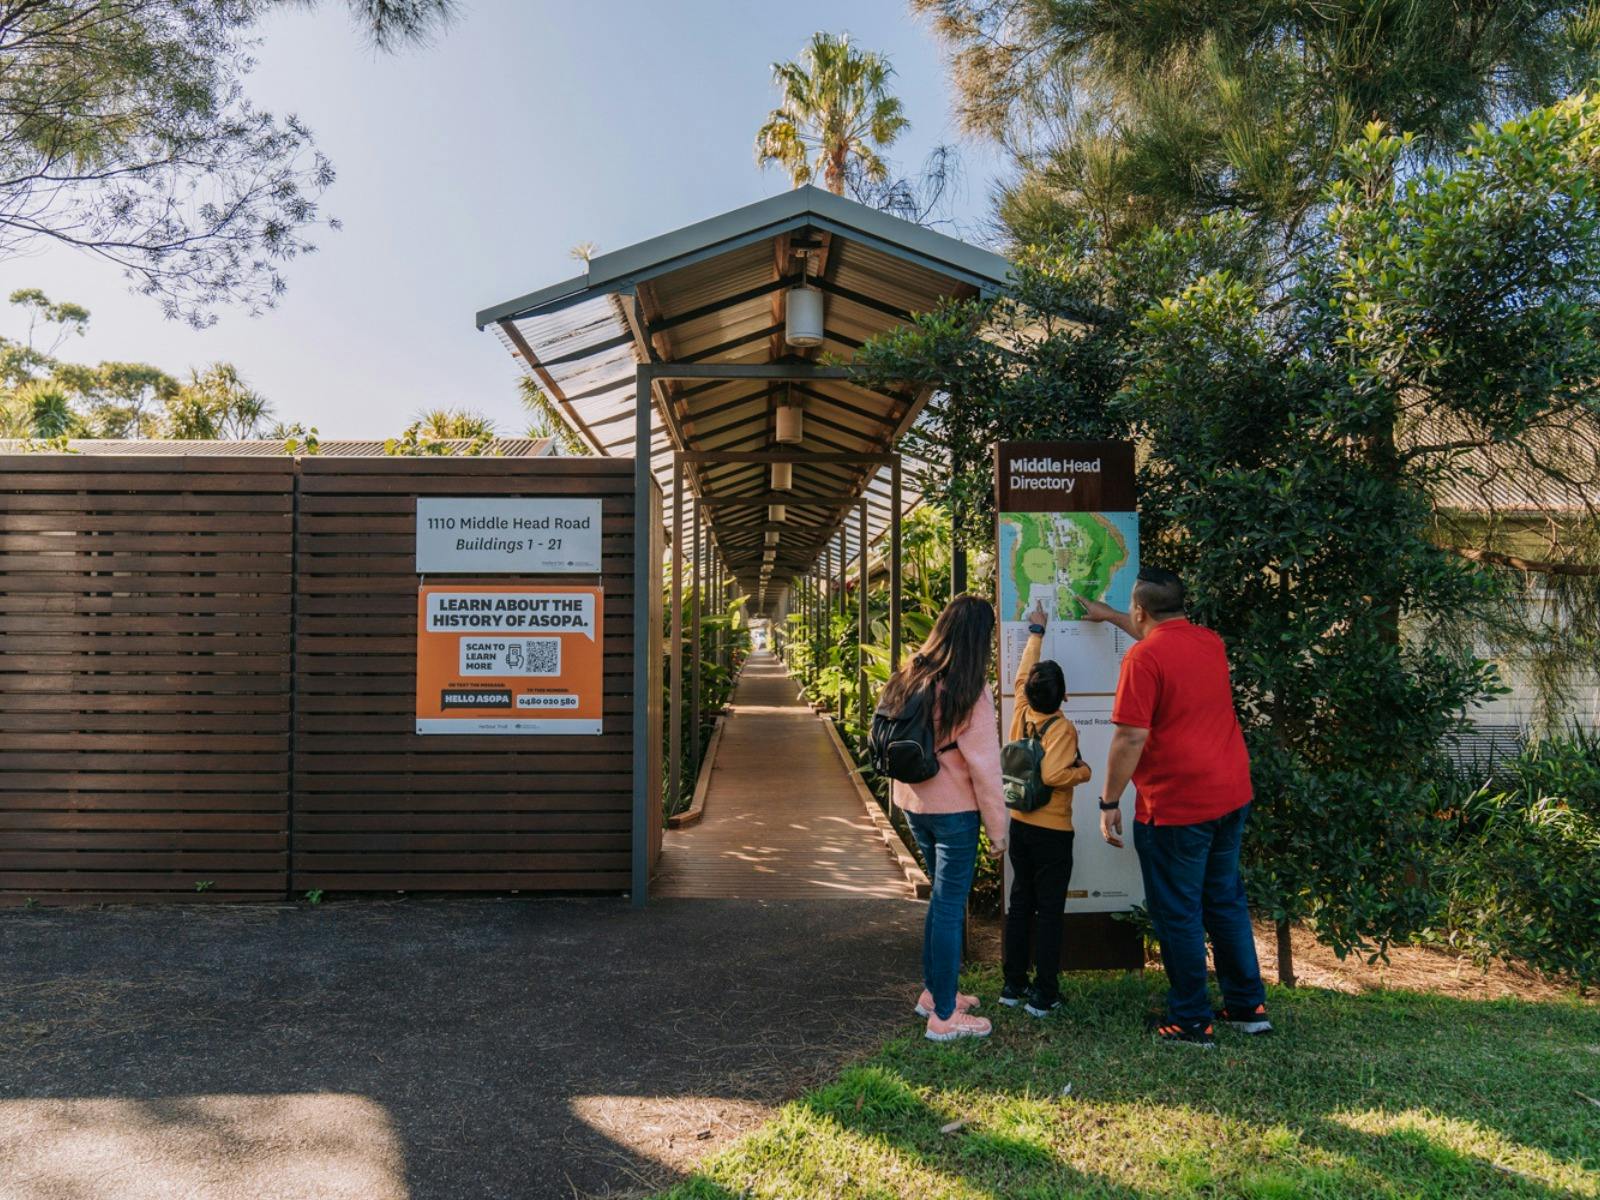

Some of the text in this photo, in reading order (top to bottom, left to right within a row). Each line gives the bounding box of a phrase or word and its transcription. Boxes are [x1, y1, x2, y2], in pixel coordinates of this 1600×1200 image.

[1010, 457, 1101, 473] Middle Head
[1010, 476, 1075, 493] Directory
[427, 516, 591, 529] 1110 Middle Head Road
[456, 538, 524, 553] Buildings
[527, 539, 533, 550] 1
[548, 539, 562, 550] 21
[439, 599, 583, 611] LEARN ABOUT THE
[433, 614, 588, 627] HISTORY OF ASOPA.
[466, 643, 505, 651] SCAN TO
[466, 662, 493, 670] MORE
[445, 694, 510, 703] HELLO ASOPA
[519, 698, 542, 706] 0480
[560, 697, 577, 706] 580
